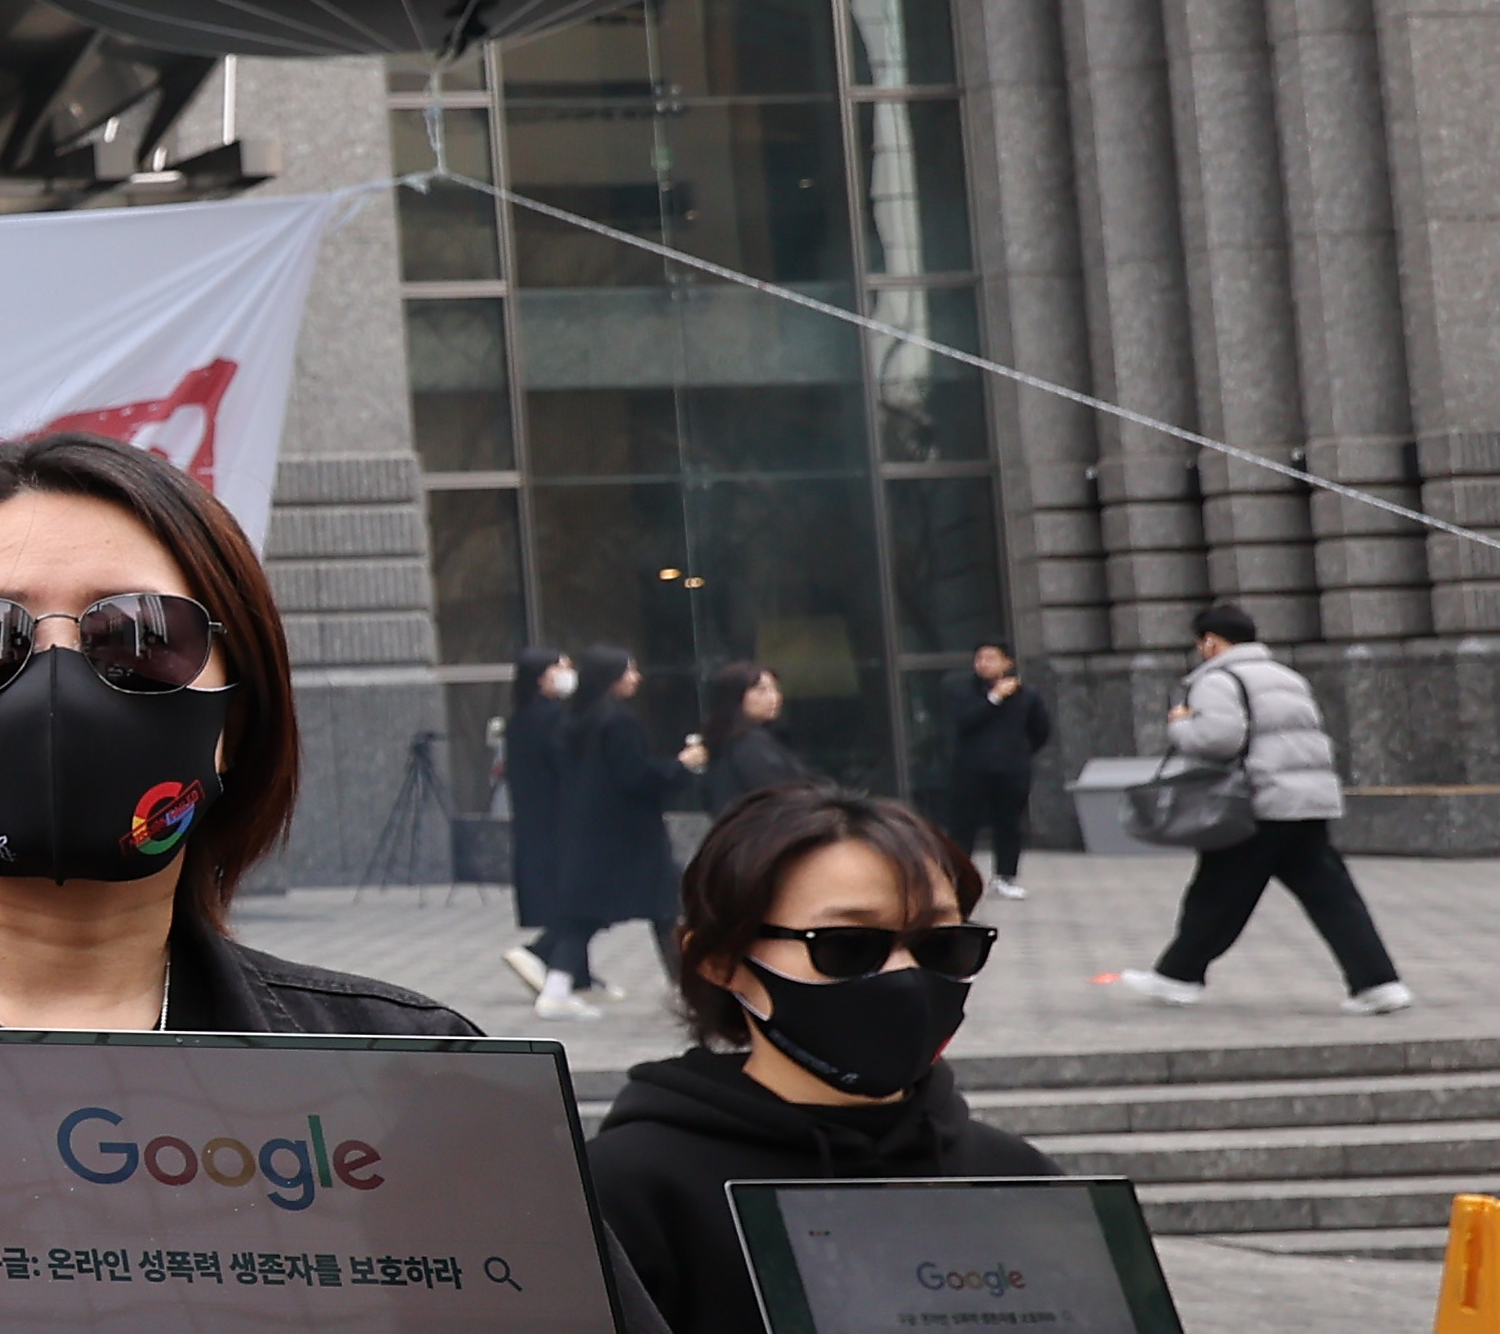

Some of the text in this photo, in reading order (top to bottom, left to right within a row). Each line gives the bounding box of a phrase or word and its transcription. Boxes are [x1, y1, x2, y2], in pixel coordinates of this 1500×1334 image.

[56, 1106, 385, 1212] Google
[47, 1248, 131, 1283] 온라인
[138, 1250, 223, 1284] 성폭력
[229, 1251, 341, 1287] 생존자를
[350, 1255, 463, 1290] 보호하라
[915, 1261, 1026, 1297] Google
